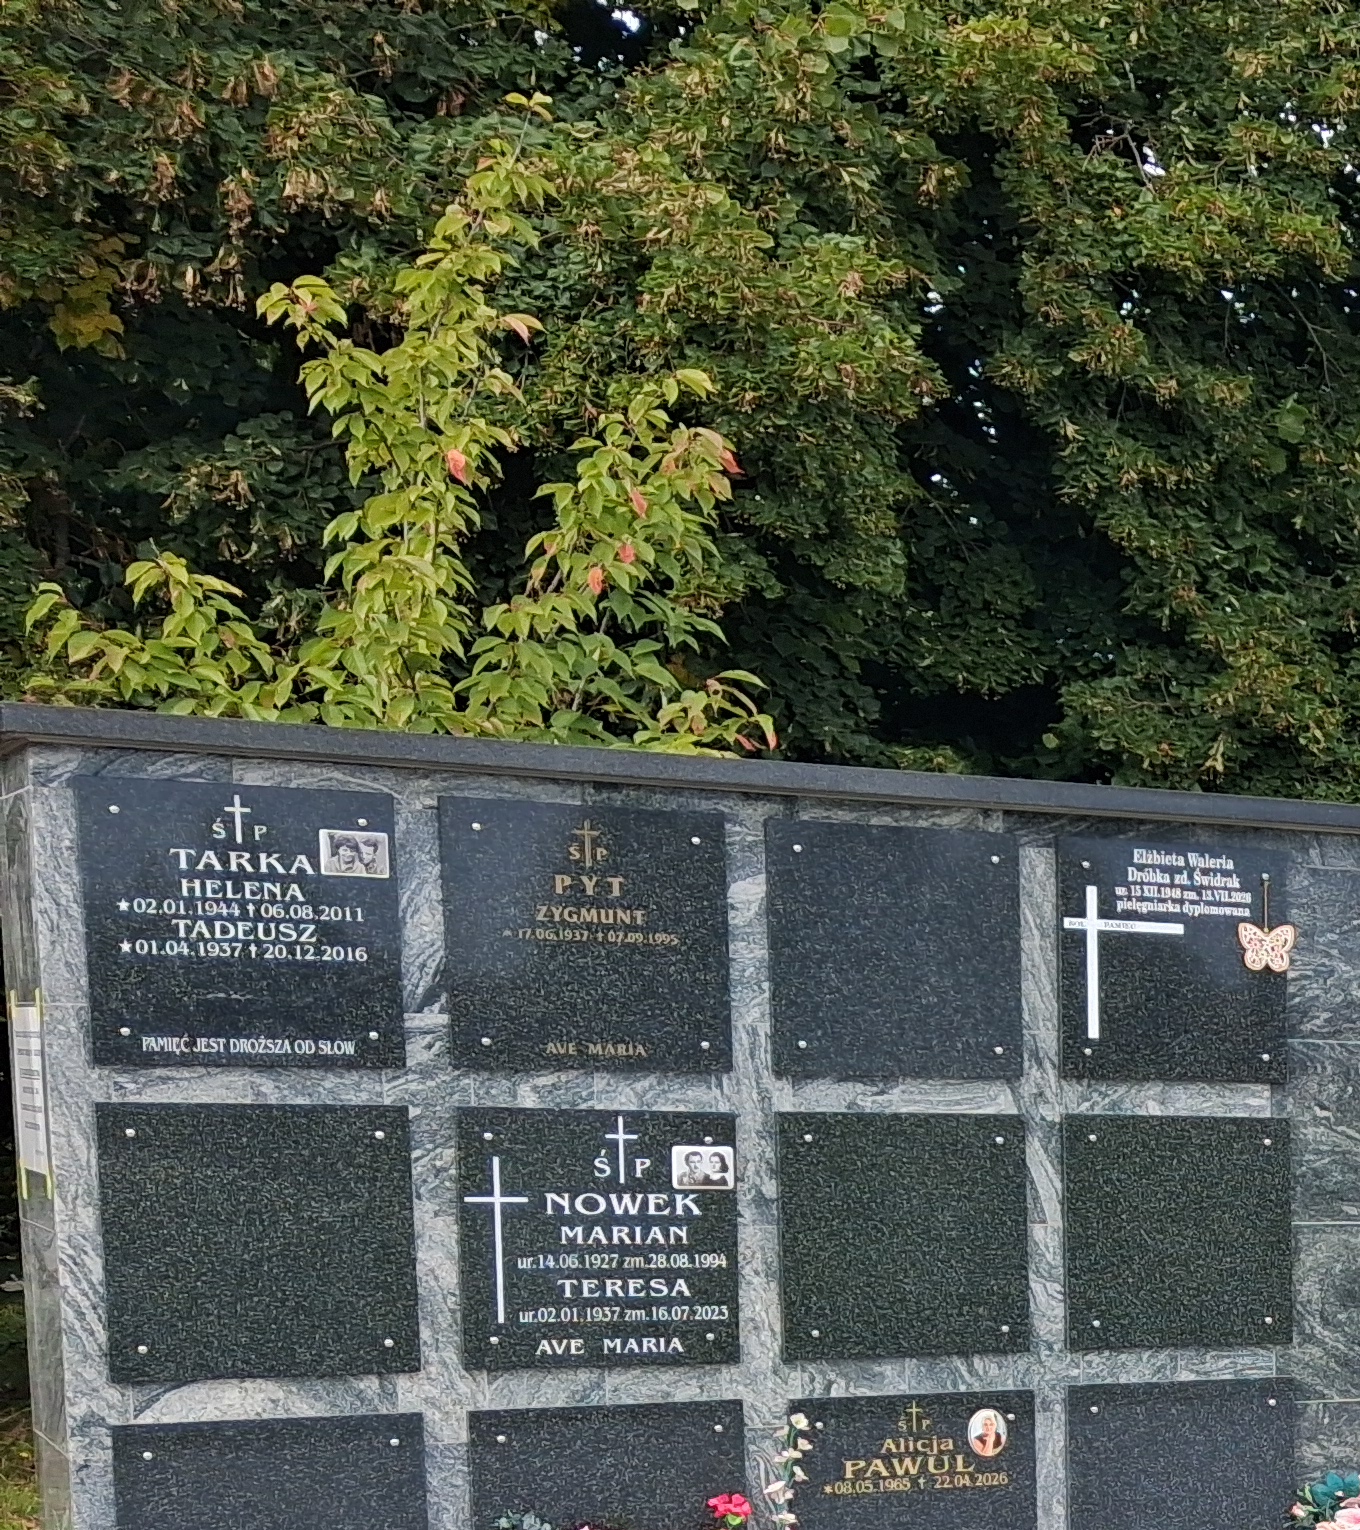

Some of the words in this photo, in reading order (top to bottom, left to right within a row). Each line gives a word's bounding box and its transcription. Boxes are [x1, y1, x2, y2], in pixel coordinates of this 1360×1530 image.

[253, 825, 268, 841] P
[168, 847, 317, 876] TARKA
[1133, 848, 1186, 867] Elżbieta
[1187, 852, 1235, 870] Waleria
[180, 877, 307, 902] HELENA
[132, 897, 241, 918] 02.01.1944
[260, 903, 364, 923] 06.08.2011
[535, 905, 647, 926] ZYGMUNT
[171, 918, 318, 943] TADEUSZ
[135, 939, 242, 958] 01.04.1937
[263, 943, 369, 962] 20.12.2016
[191, 1037, 227, 1054] JEST
[294, 1038, 316, 1055] OD
[546, 1042, 577, 1055] AVE
[588, 1043, 648, 1057] MARIA
[594, 1149, 611, 1178] Ś
[634, 1158, 651, 1177] P
[544, 1192, 702, 1216] NOWEK
[560, 1226, 689, 1245] MARIAN
[557, 1278, 692, 1298] TERESA
[535, 1338, 585, 1356] AVE
[603, 1337, 685, 1354] MARIA
[880, 1435, 954, 1455] Alicja
